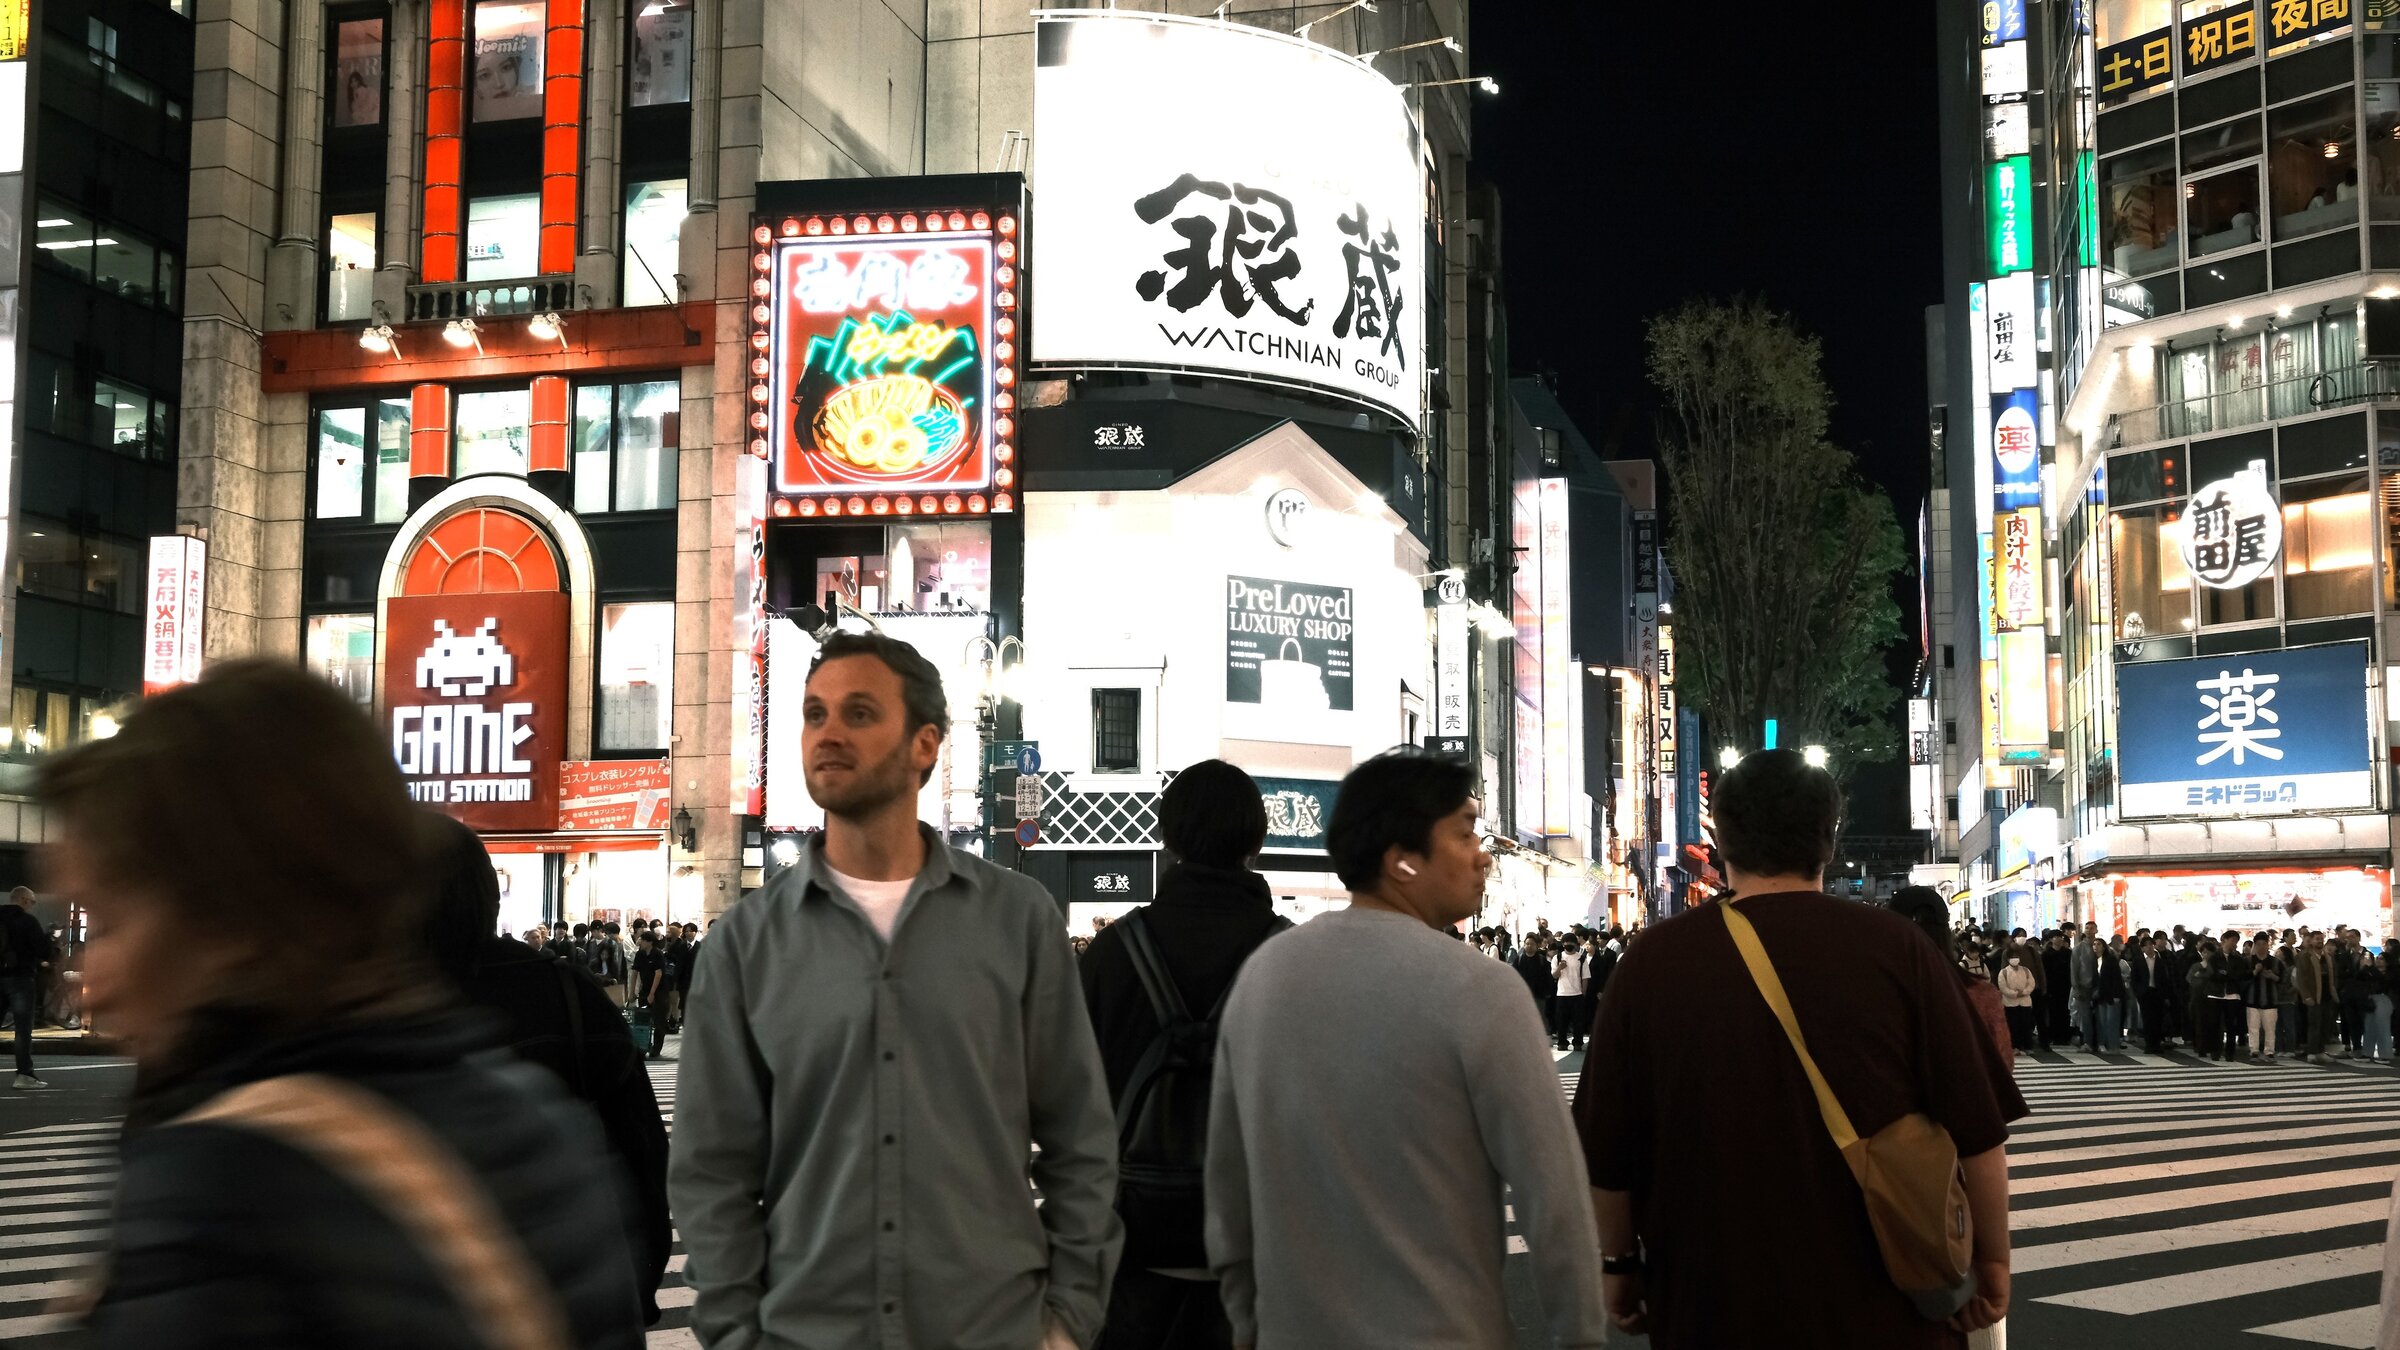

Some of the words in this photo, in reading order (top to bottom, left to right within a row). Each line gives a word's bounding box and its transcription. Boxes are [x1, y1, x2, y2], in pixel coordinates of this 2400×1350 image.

[475, 35, 528, 56] loomit
[1982, 34, 1998, 45] 6F
[2188, 9, 2255, 66] 祝日
[1989, 94, 2003, 104] 5F
[1133, 171, 1407, 372] 銀蔵
[1993, 312, 2015, 363] 前田屋
[1158, 322, 1342, 371] WATCHNIAN
[1354, 356, 1400, 391] GROUP
[1094, 425, 1145, 447] 銀蔵
[1998, 425, 2032, 456] 薬
[2006, 515, 2032, 622] 肉汁水餃子
[1228, 578, 1352, 621] PreLoved
[1230, 611, 1301, 637] LUXURY
[1304, 614, 1352, 642] SHOP
[2195, 667, 2285, 766] 薬
[393, 702, 535, 774] GAME
[407, 780, 445, 802] AITO
[450, 778, 531, 802] STATION
[1093, 874, 1131, 890] 銀蔵
